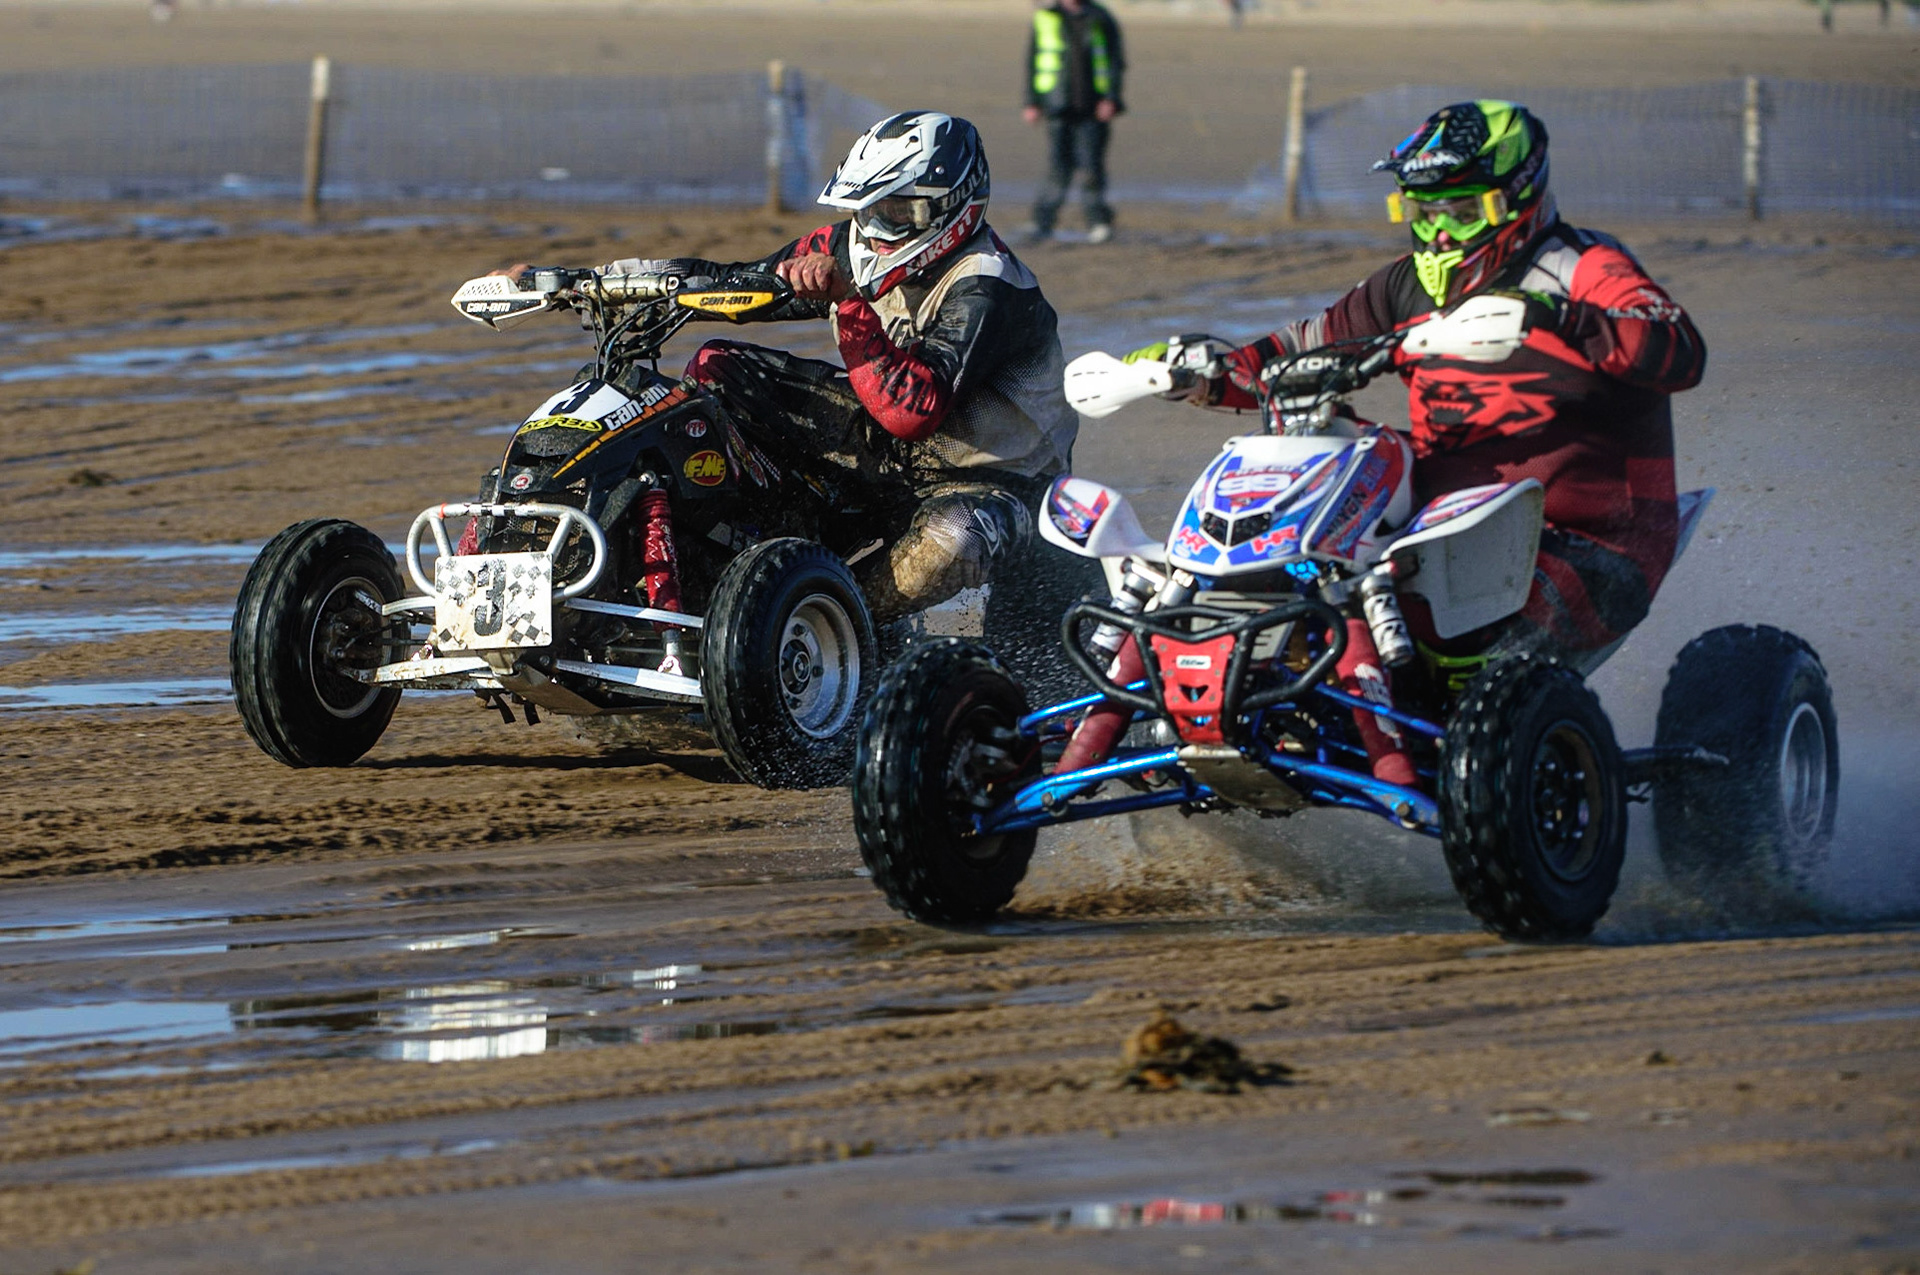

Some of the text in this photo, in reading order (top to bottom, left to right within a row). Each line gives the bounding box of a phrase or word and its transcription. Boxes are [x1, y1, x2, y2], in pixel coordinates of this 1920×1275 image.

[549, 377, 604, 416] 3
[685, 454, 726, 478] FMF
[473, 558, 507, 637] 3
